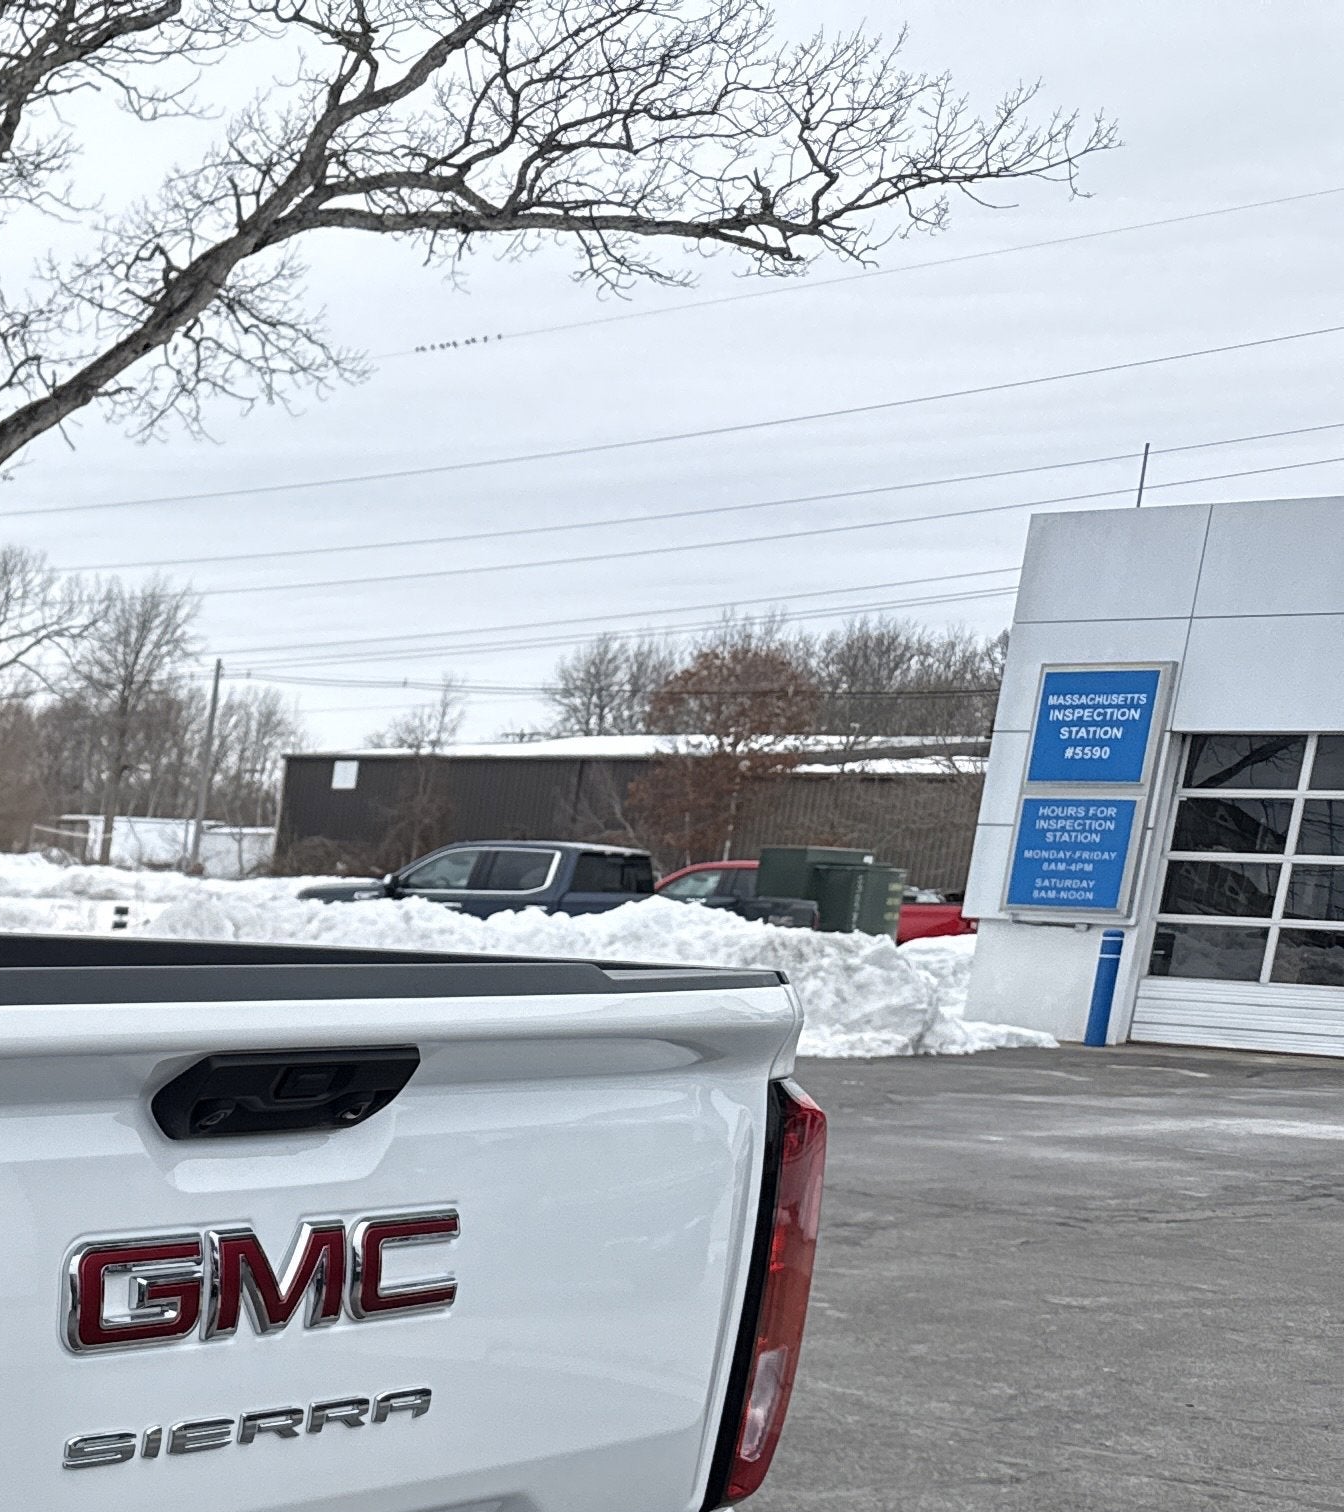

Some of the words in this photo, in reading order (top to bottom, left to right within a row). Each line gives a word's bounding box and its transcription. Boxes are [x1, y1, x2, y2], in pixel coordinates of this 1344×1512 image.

[1048, 693, 1148, 706] MASSACHUSETTS
[1049, 708, 1141, 721] INSPECTION
[1059, 726, 1124, 740] STATION
[1064, 746, 1111, 760] #5590
[1038, 806, 1086, 817] HOURS
[1088, 806, 1118, 818] FOR
[1035, 819, 1116, 831] INSPECTION
[1045, 831, 1101, 843] STATION
[1023, 849, 1118, 860] MONDAY-FRIDAY
[1034, 878, 1096, 889] SATURDAY
[1032, 889, 1094, 900] 8AM-NOON
[60, 1208, 461, 1353] GMC
[62, 1385, 433, 1471] SIERRA
